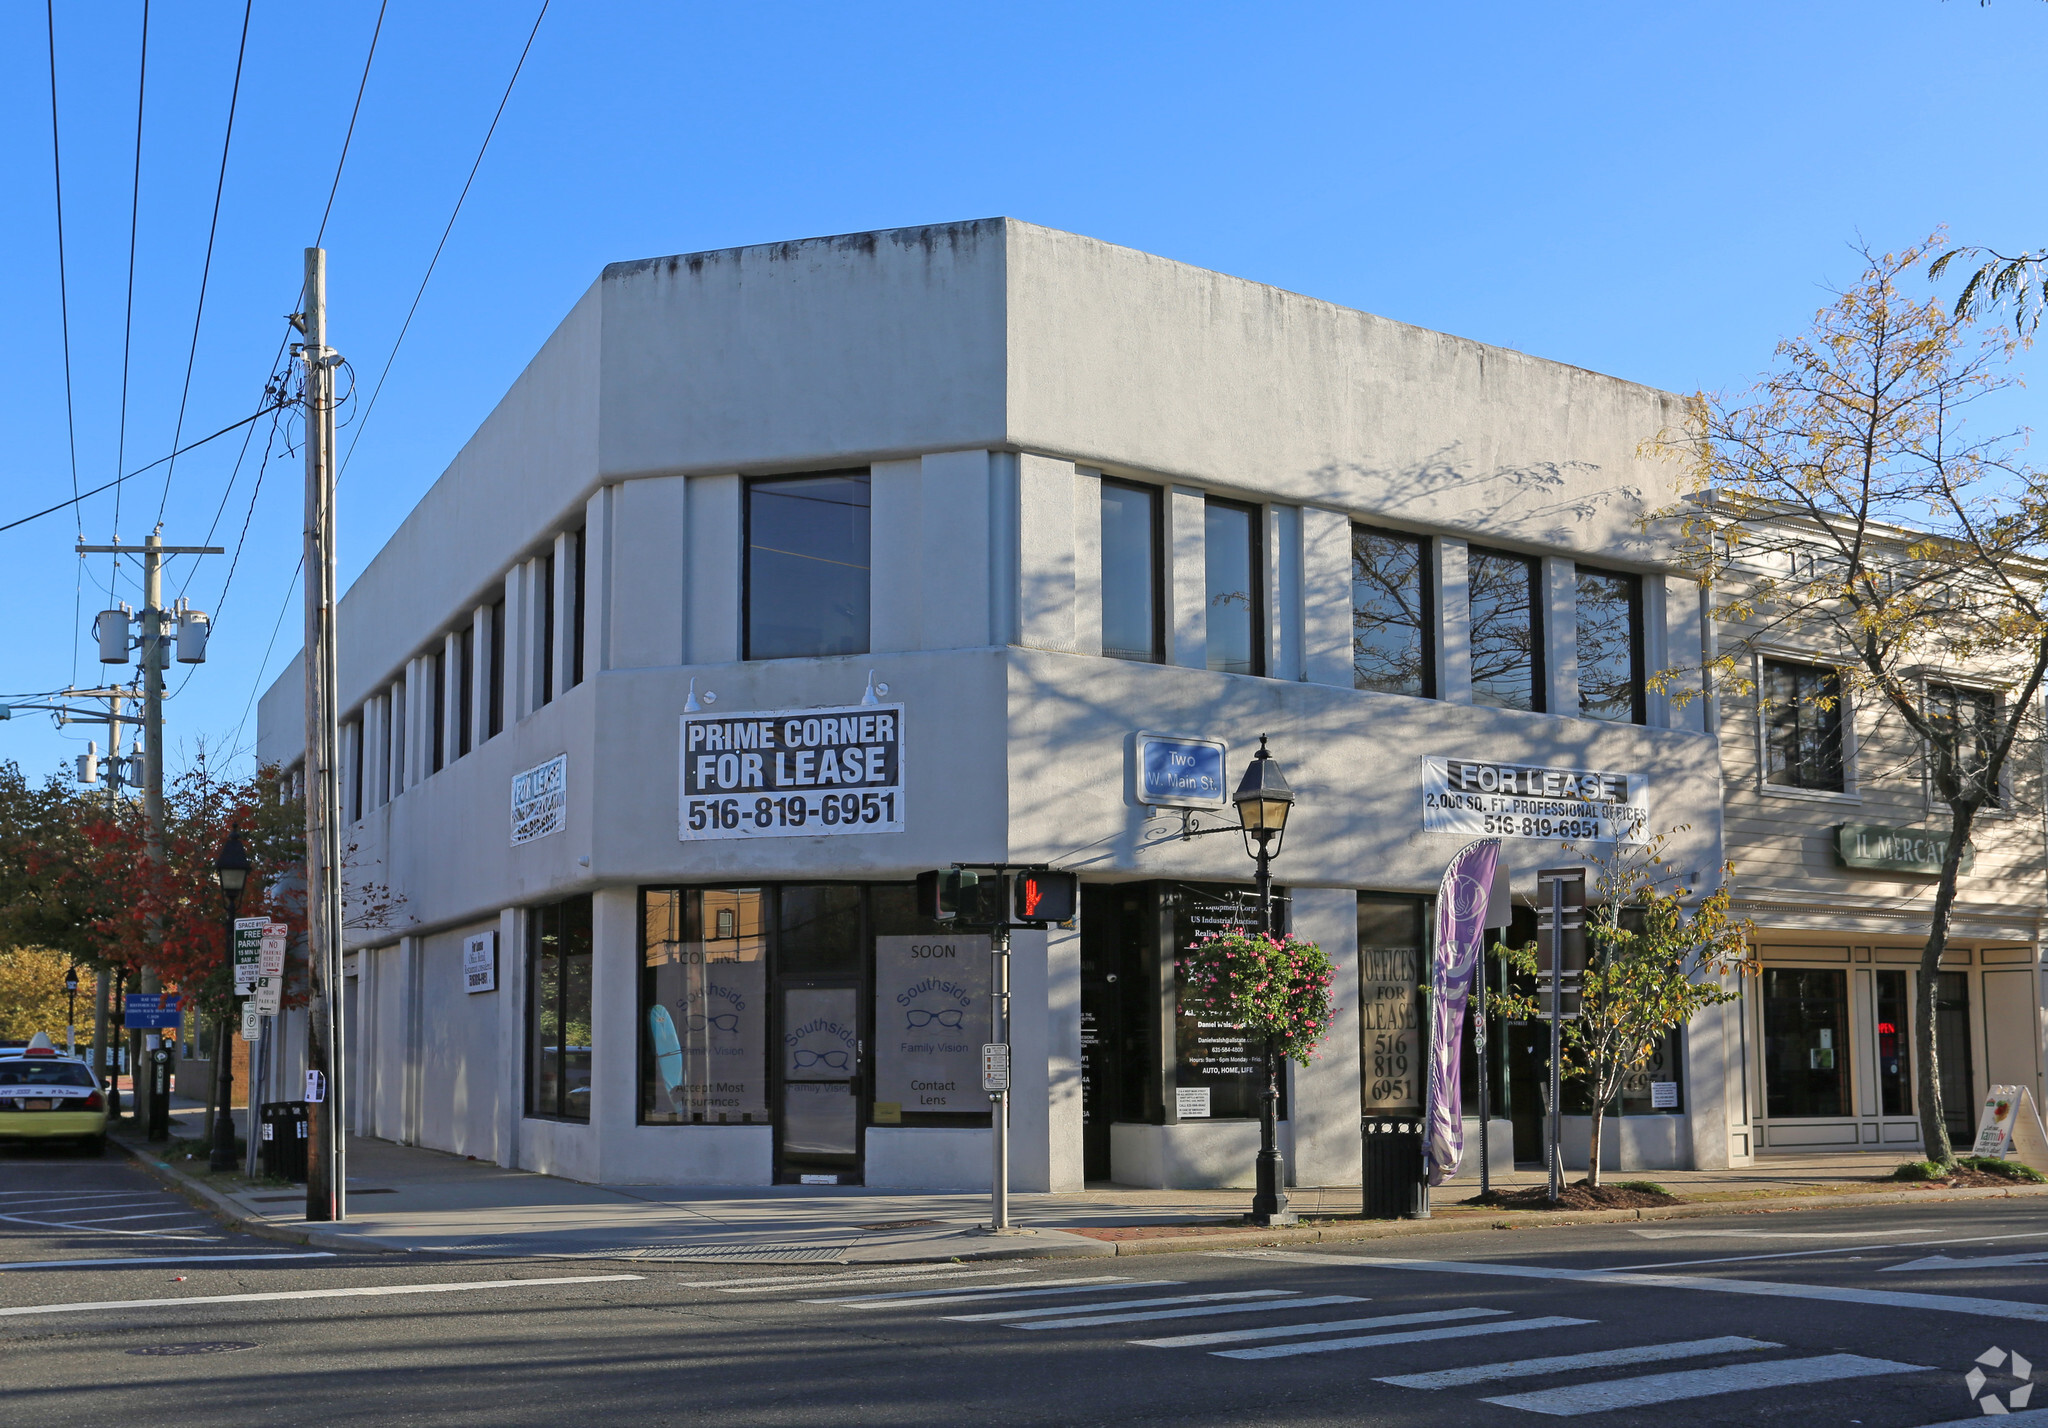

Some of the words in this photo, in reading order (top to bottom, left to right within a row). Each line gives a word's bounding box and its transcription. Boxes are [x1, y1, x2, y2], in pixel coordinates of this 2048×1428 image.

[688, 721, 775, 752] PRIME
[784, 714, 895, 748] CORNER
[696, 753, 764, 790] FOR
[775, 746, 886, 787] LEASE
[1168, 750, 1196, 767] Two
[1147, 771, 1164, 786] W.
[1167, 773, 1197, 789] Main
[1200, 775, 1217, 791] St.
[1460, 764, 1518, 794] FOR
[1527, 770, 1616, 800] LEASE
[688, 792, 895, 831] 516-819-6951
[1426, 792, 1463, 811] 2,000
[1466, 796, 1487, 812] SQ.
[1491, 798, 1509, 813] FT.
[1513, 799, 1599, 819] PROFESSIONAL
[1602, 804, 1647, 822] OFFICES
[1484, 815, 1600, 840] 516-819-6951
[1856, 833, 1871, 859] IL
[1878, 835, 1946, 864] MERCAT
[1190, 915, 1201, 923] US
[1202, 915, 1233, 925] Industrial
[1234, 917, 1261, 925] Auction
[238, 939, 262, 949] PARKIN
[243, 930, 261, 939] FREE
[268, 941, 278, 949] NO
[911, 944, 956, 959] SOON
[1364, 950, 1416, 982] OFFICES
[260, 978, 267, 987] 2
[897, 976, 971, 1008] Southside
[676, 982, 746, 1013] Southside
[1377, 986, 1406, 1000] FOR
[1365, 1002, 1417, 1030] LEASE
[784, 1017, 856, 1049] Southside
[714, 1046, 744, 1056] Vision
[901, 1042, 934, 1055] Family
[937, 1042, 969, 1053] Vision
[1374, 1033, 1407, 1055] 516
[1202, 1067, 1220, 1075] AUTO,
[1221, 1067, 1240, 1075] HOME,
[1374, 1055, 1408, 1078] 819
[716, 1082, 745, 1093] Most
[787, 1083, 821, 1095] Family
[823, 1083, 851, 1093] Visio
[911, 1080, 956, 1092] Contact
[1371, 1079, 1412, 1101] 6951
[920, 1094, 947, 1106] Lens
